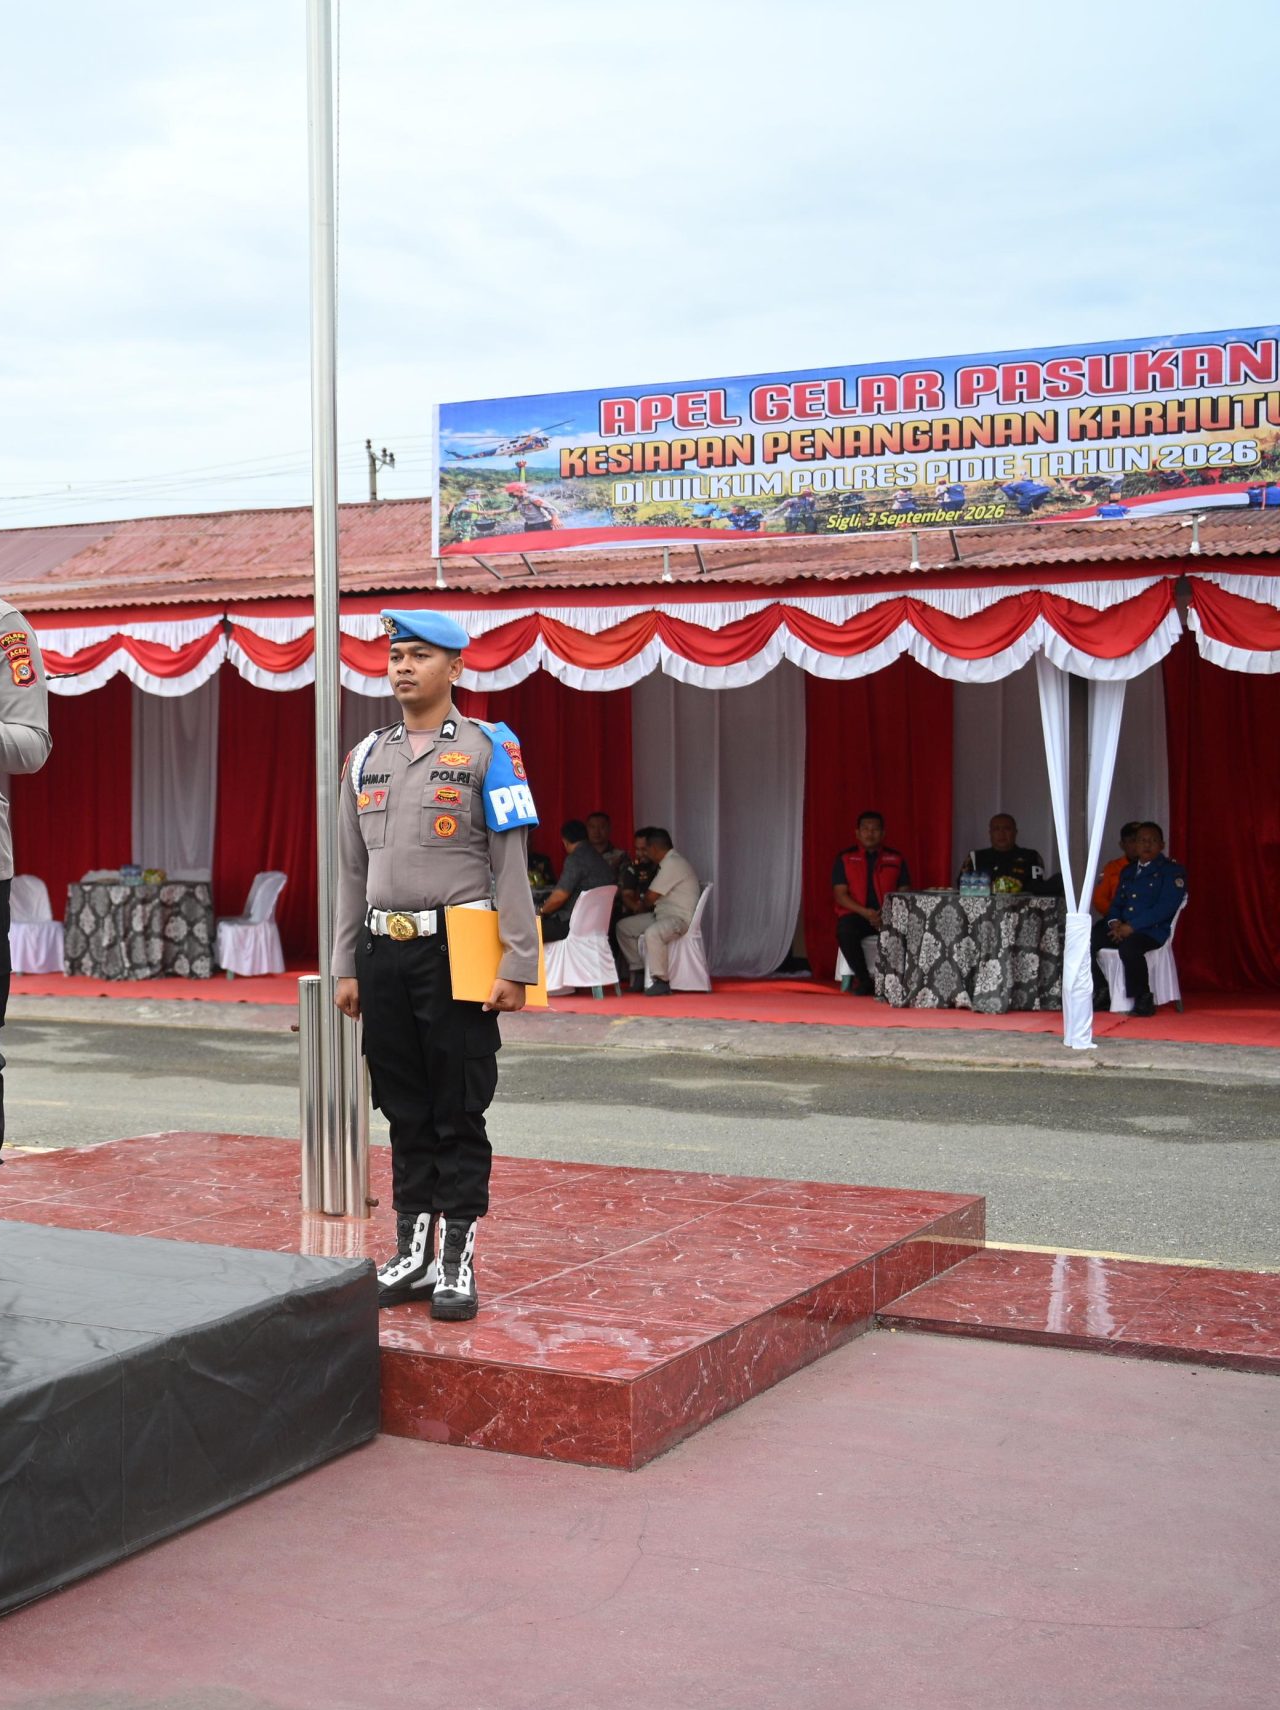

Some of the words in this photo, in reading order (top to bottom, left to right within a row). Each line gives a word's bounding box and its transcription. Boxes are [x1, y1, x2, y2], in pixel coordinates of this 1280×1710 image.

[599, 388, 741, 437] APEL
[750, 371, 943, 425] GELAR
[955, 339, 1277, 408] PASUKAN
[559, 433, 754, 479] KESIAPAN
[763, 410, 1057, 464] PENANGANAN
[614, 481, 646, 506] DI
[651, 471, 784, 503] WILKUM
[790, 462, 917, 494] POLRES
[925, 455, 1016, 485] PIDIE
[1024, 445, 1151, 478] TAHUN
[1159, 439, 1261, 469] 2026
[826, 513, 862, 531] Sigli,
[865, 512, 876, 527] 3
[878, 508, 962, 527] September
[964, 504, 1006, 520] 2026
[429, 770, 471, 784] POLRI
[488, 784, 538, 826] PR
